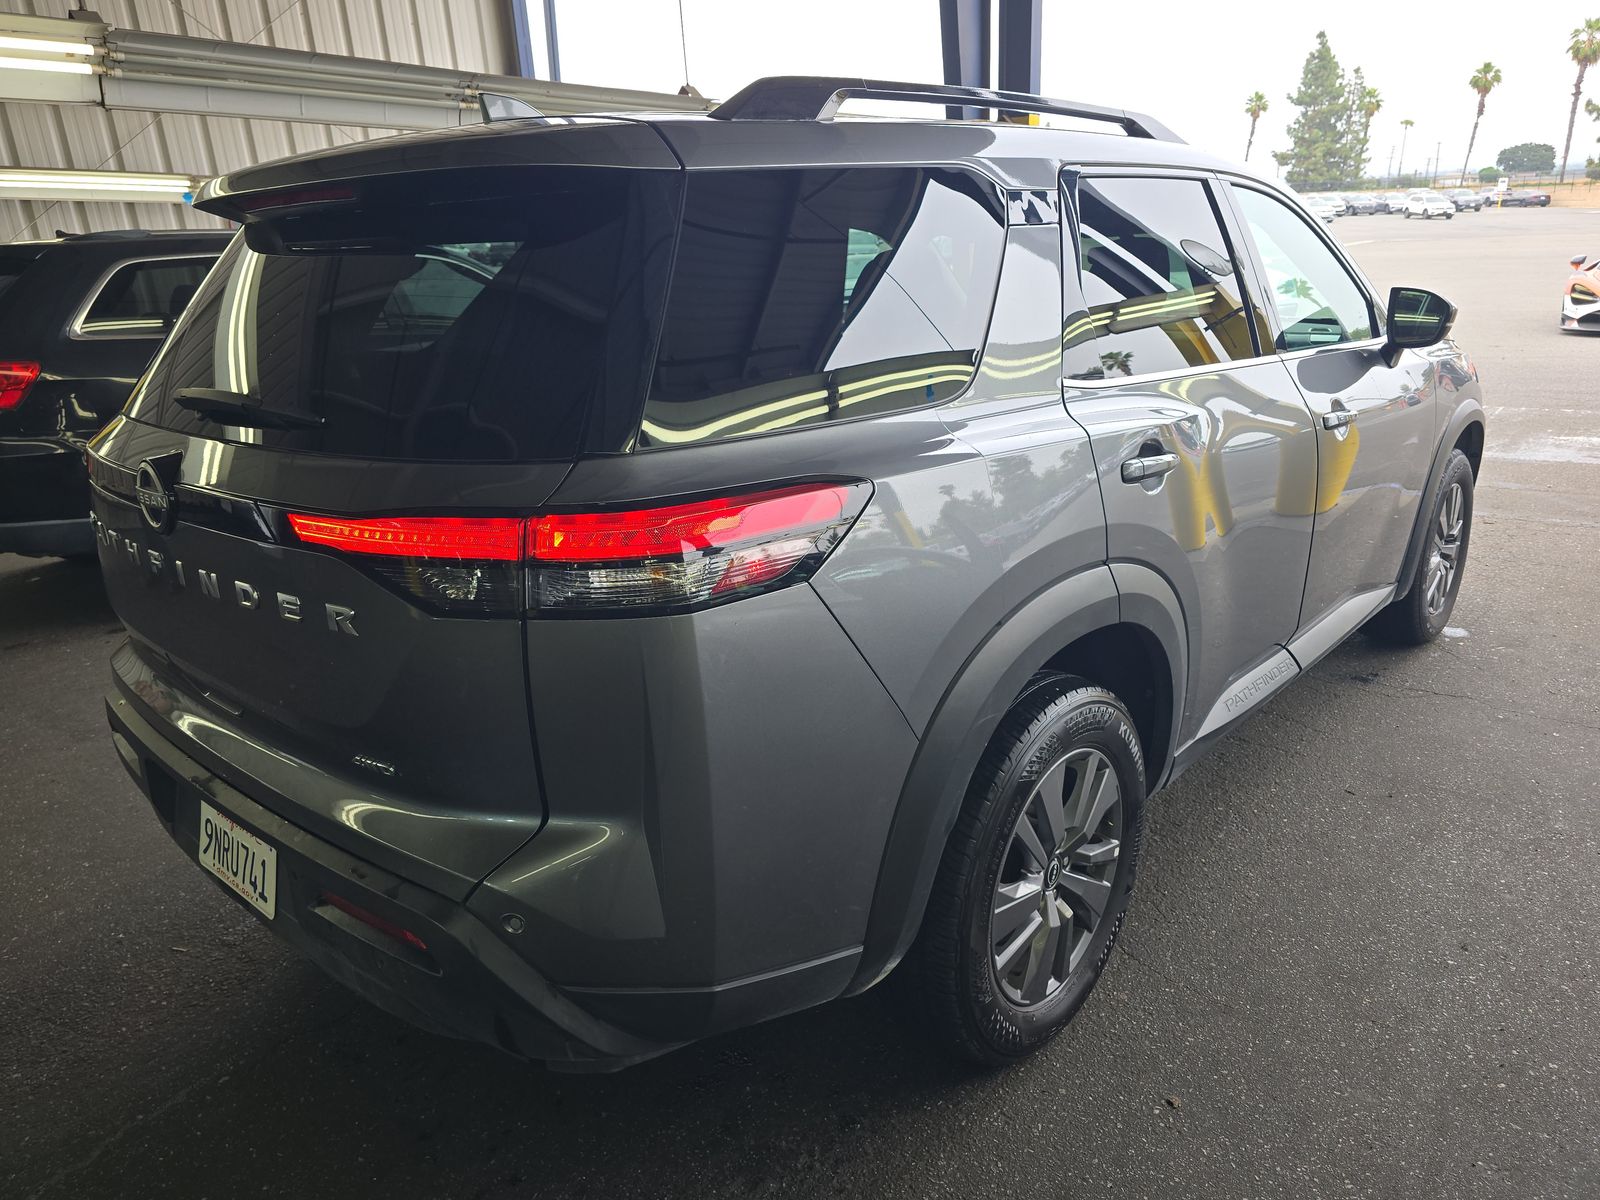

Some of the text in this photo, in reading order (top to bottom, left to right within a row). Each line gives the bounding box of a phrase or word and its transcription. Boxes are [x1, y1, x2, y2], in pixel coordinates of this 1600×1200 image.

[137, 490, 168, 509] SSAN
[1224, 657, 1294, 713] PATHFINDER
[203, 818, 268, 904] 9NRU741
[216, 867, 255, 901] dmv.ca.gov
